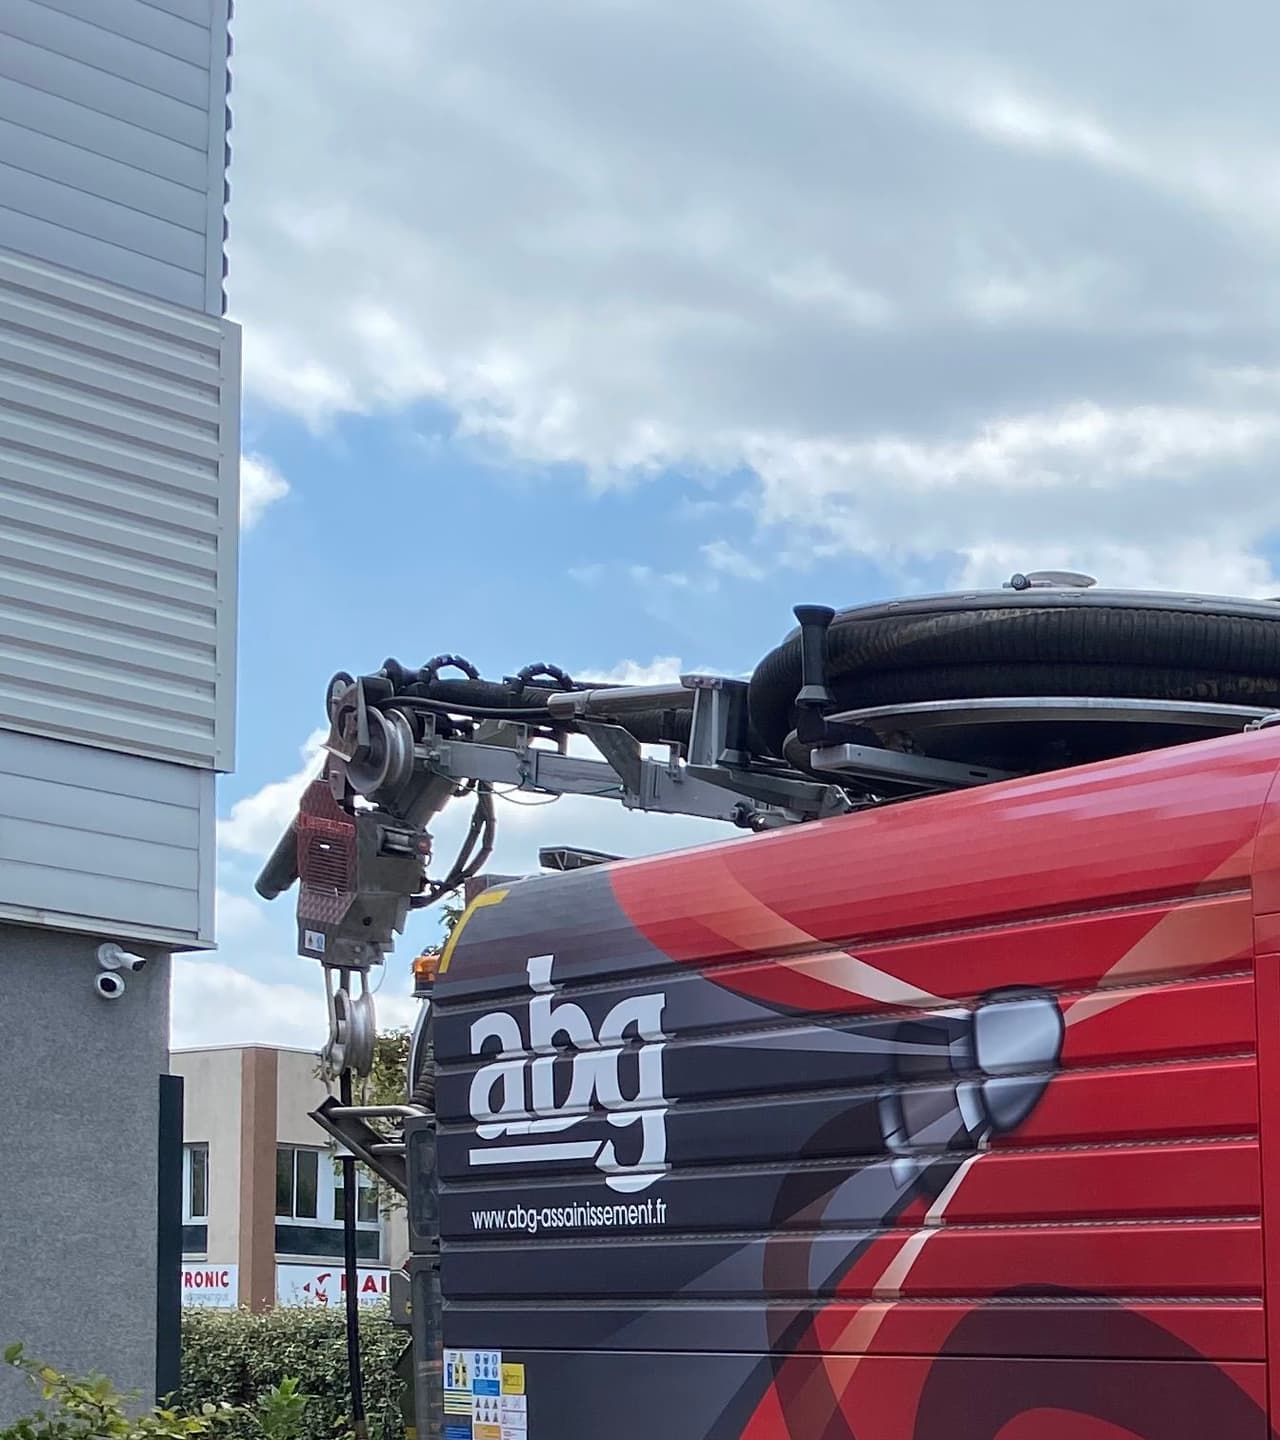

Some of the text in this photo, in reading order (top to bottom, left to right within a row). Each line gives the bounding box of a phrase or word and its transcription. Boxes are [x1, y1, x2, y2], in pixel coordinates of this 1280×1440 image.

[468, 953, 668, 1194] abg
[471, 1198, 667, 1234] www.abg-assainissement.fr
[182, 1270, 230, 1288] RONIC
